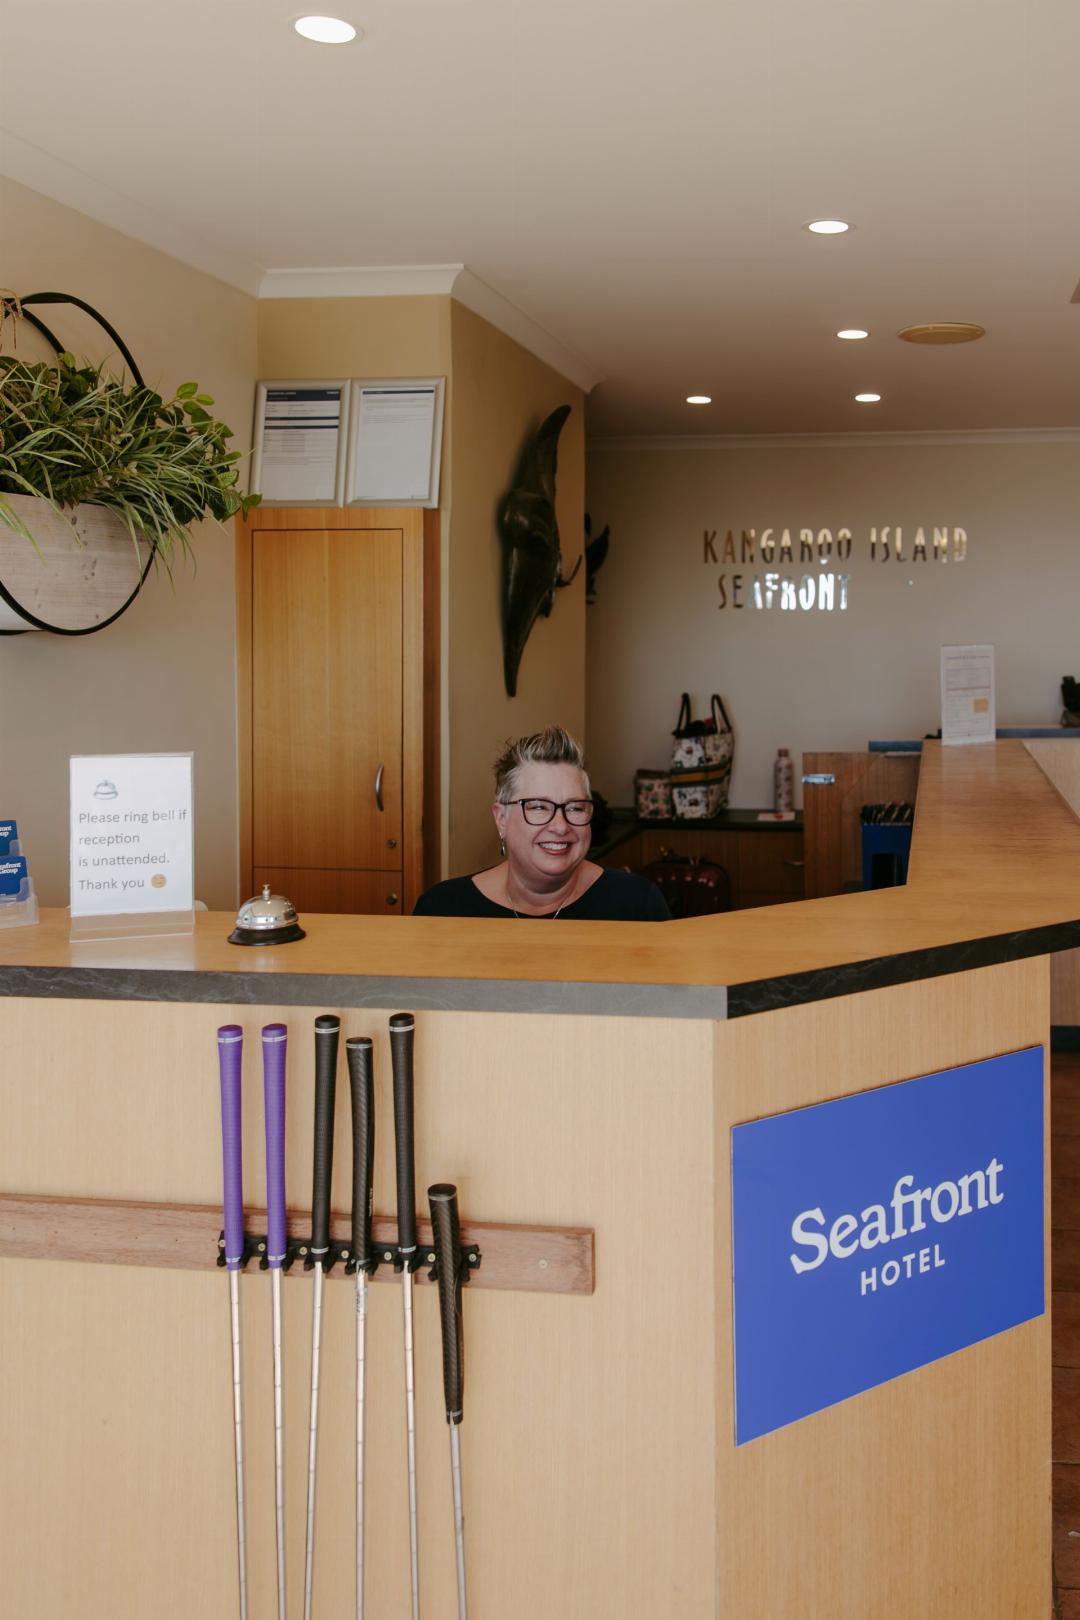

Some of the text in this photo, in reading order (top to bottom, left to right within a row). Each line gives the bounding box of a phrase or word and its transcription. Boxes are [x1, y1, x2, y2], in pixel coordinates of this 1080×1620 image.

[703, 527, 967, 564] KANGAROO ISLAND
[718, 573, 850, 610] SEAFRONT
[79, 809, 188, 824] Please ring bell if
[79, 833, 140, 847] reception
[79, 852, 170, 867] is unattended.
[78, 878, 145, 891] Thank you
[790, 1158, 1004, 1274] Seafront
[861, 1244, 946, 1296] HOTEL
